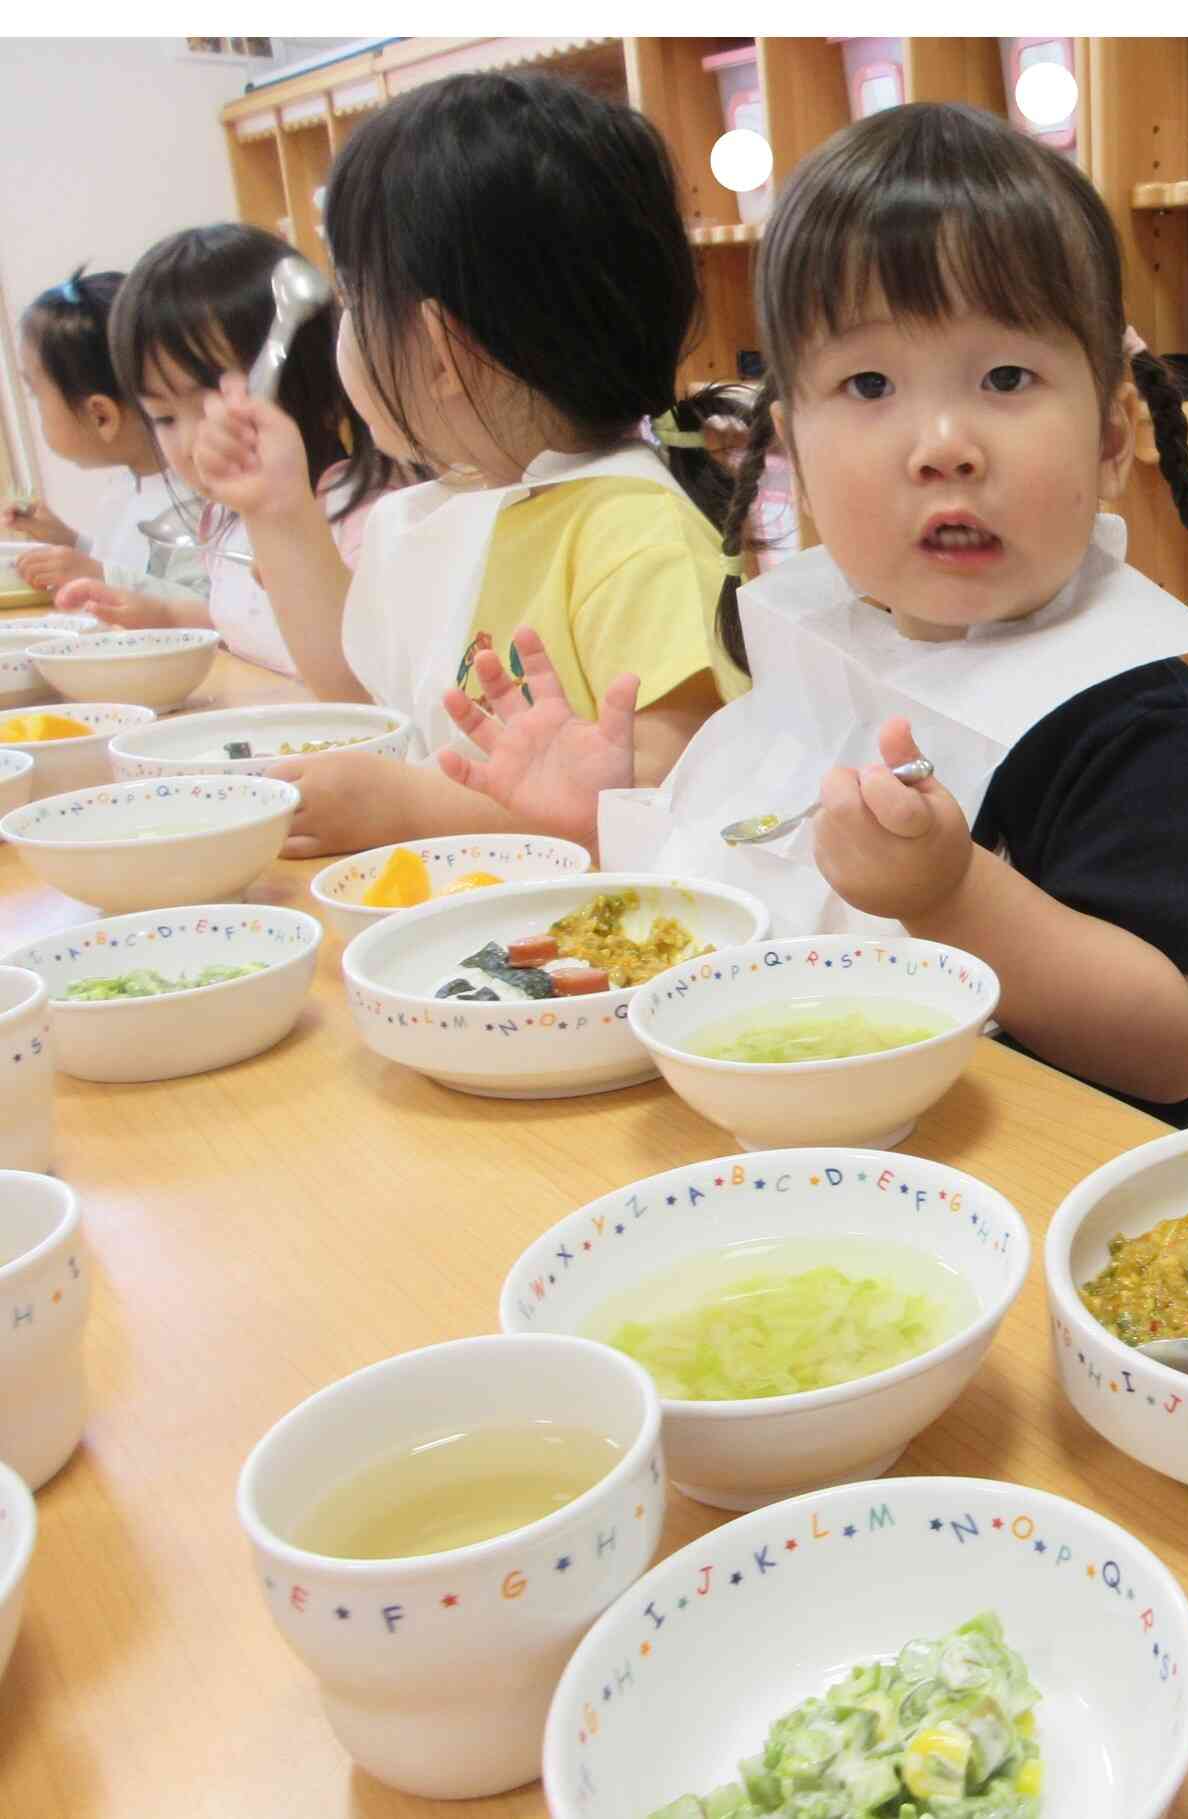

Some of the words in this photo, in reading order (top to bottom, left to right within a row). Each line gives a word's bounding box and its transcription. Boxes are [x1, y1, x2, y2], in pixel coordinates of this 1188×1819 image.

[158, 926, 172, 938] D
[225, 926, 235, 940] F
[764, 951, 784, 967] Q
[841, 954, 853, 968] S
[499, 1019, 517, 1036] N
[540, 1012, 556, 1027] O
[556, 1243, 575, 1268] X
[625, 1194, 648, 1218] Z
[688, 1186, 706, 1207] A
[731, 1165, 745, 1185] B
[776, 1174, 791, 1192] C
[825, 1168, 843, 1186] D
[876, 1169, 895, 1191] E
[915, 1190, 927, 1212] F
[1121, 1370, 1136, 1393] I
[1163, 1394, 1184, 1414] J
[380, 1605, 404, 1633] F
[502, 1570, 528, 1599] G
[596, 1526, 616, 1558] H
[643, 1601, 665, 1630] I
[697, 1565, 714, 1596] J
[754, 1545, 776, 1574] K
[812, 1512, 830, 1539] L
[869, 1504, 896, 1530] M
[950, 1514, 980, 1543] N
[1011, 1515, 1034, 1540] O
[1056, 1544, 1072, 1566] P
[1102, 1560, 1121, 1596] Q
[1139, 1608, 1153, 1633] R
